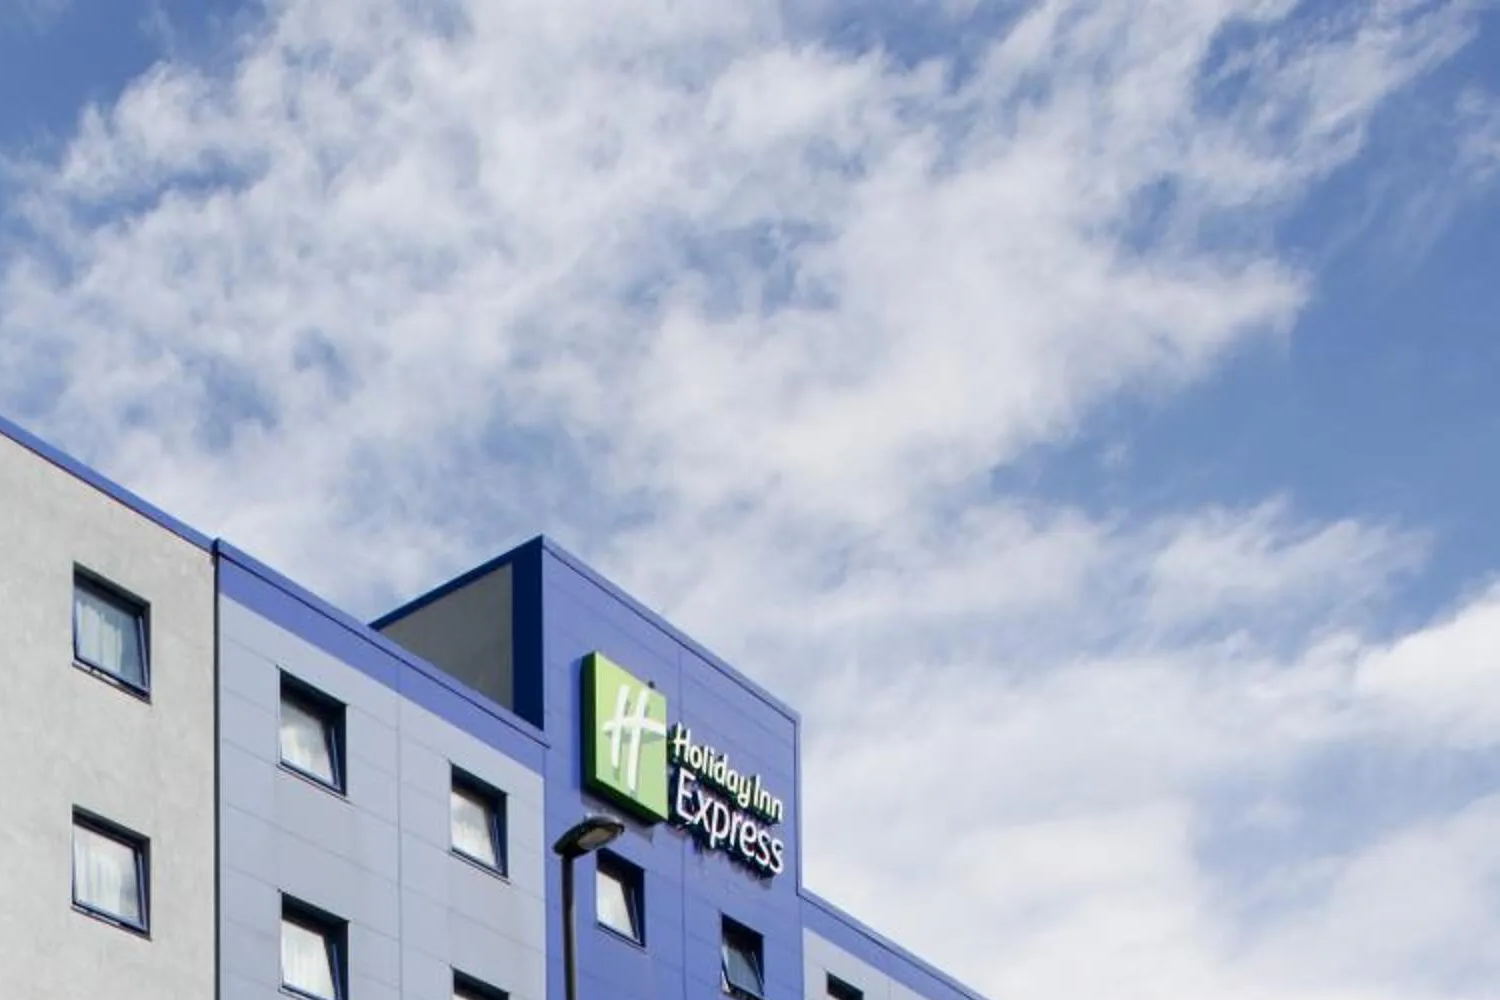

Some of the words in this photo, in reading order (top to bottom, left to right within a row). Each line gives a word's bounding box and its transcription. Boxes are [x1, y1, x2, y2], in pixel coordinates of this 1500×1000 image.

[673, 721, 751, 809] Holiday
[753, 773, 784, 822] Inn
[675, 767, 785, 875] Express
